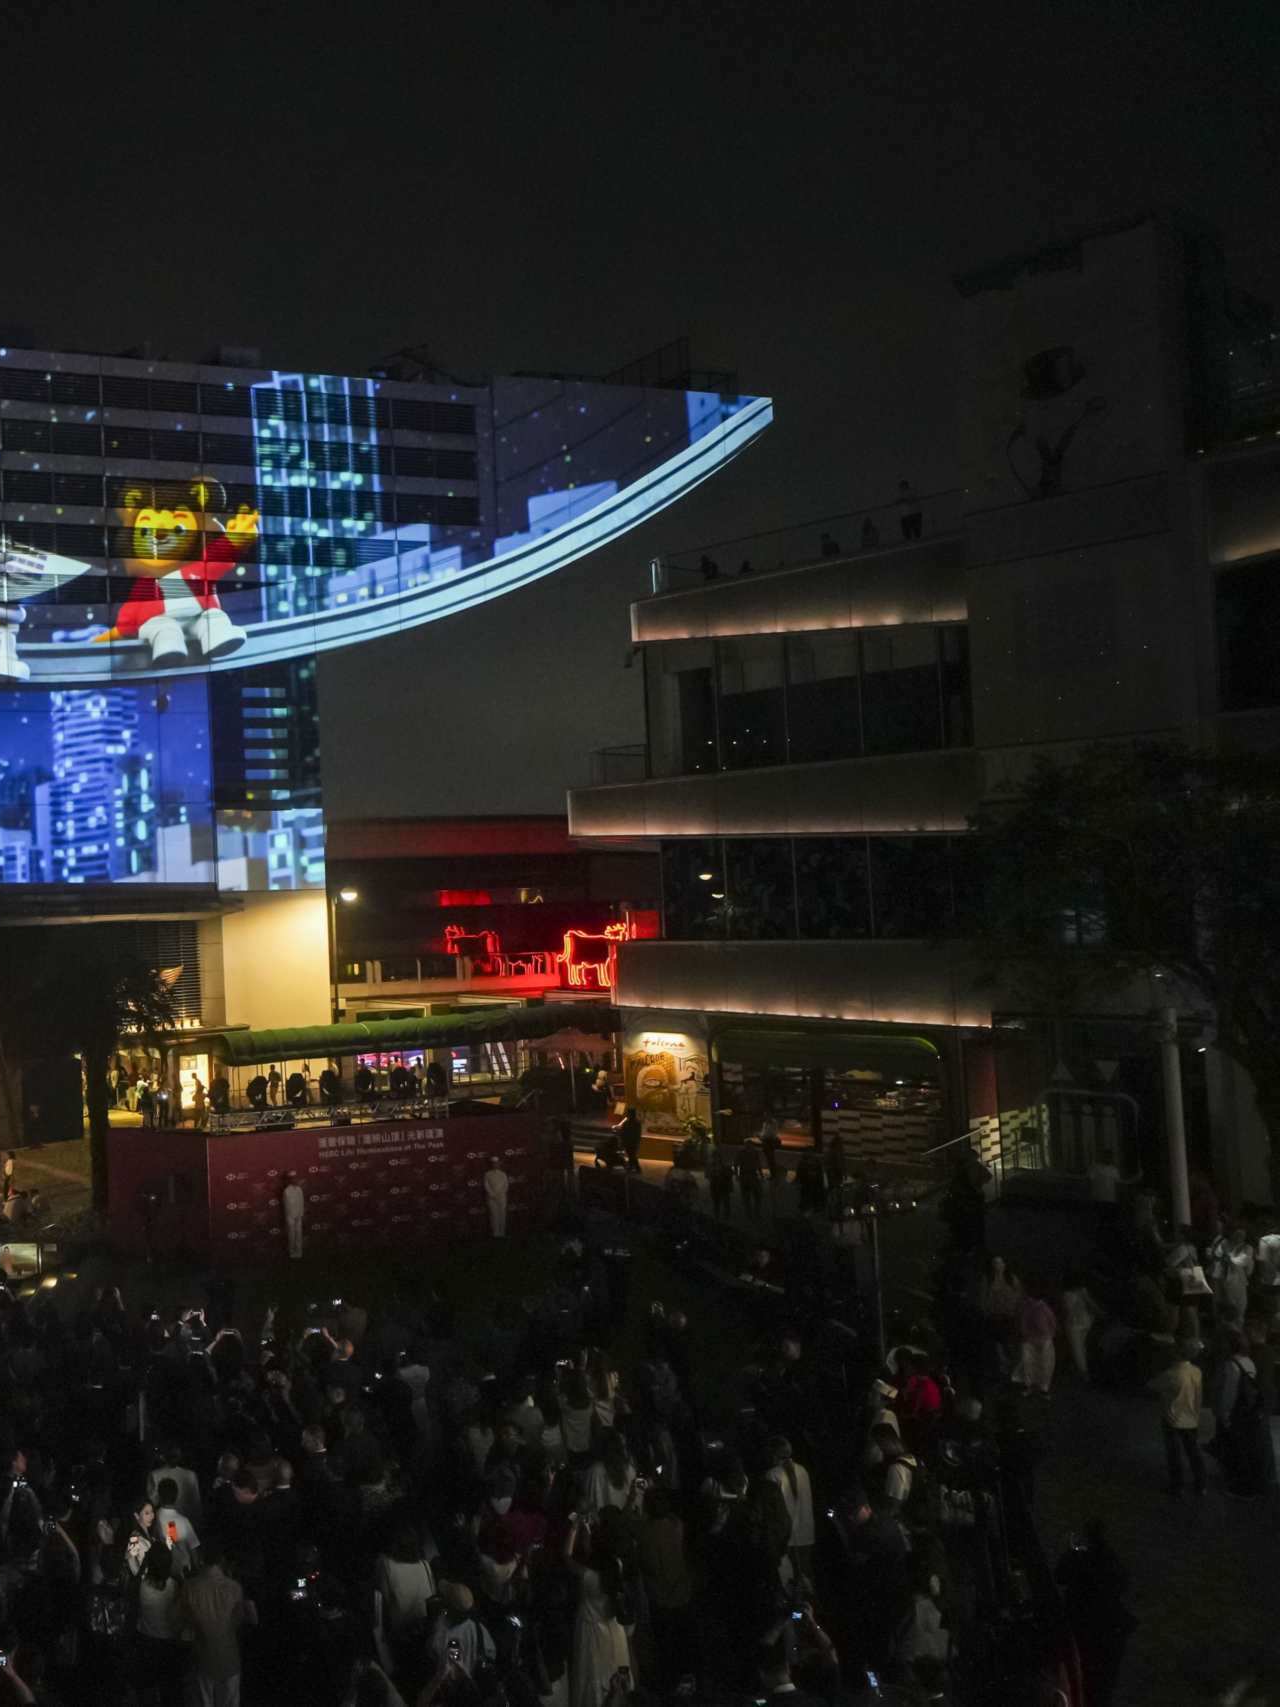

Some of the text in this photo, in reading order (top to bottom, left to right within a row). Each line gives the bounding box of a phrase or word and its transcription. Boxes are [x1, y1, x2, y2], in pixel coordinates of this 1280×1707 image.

[318, 1148, 339, 1158] HSBC
[341, 1148, 355, 1156] Life
[356, 1144, 402, 1155] Illuminations
[413, 1142, 425, 1150] The
[428, 1140, 444, 1148] Peak
